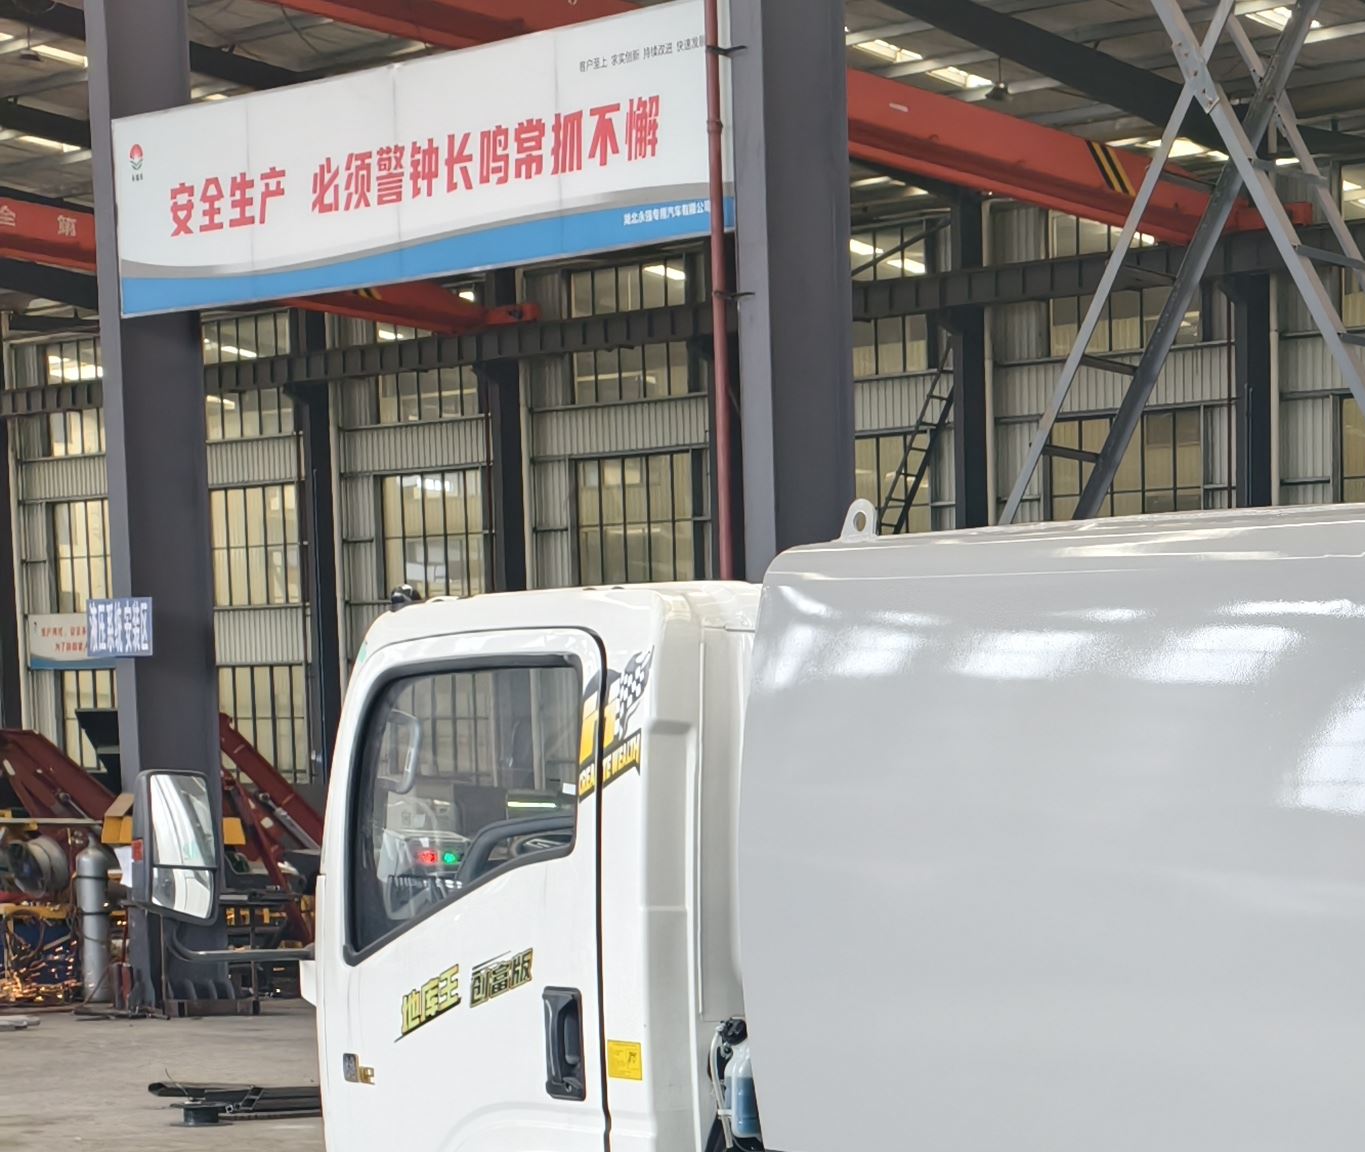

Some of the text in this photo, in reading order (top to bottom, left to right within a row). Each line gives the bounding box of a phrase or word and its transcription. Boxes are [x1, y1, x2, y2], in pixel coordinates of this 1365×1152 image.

[170, 95, 660, 237] 安全生产 必须警钟长鸣常抓不懈
[401, 964, 460, 1036] 地库王
